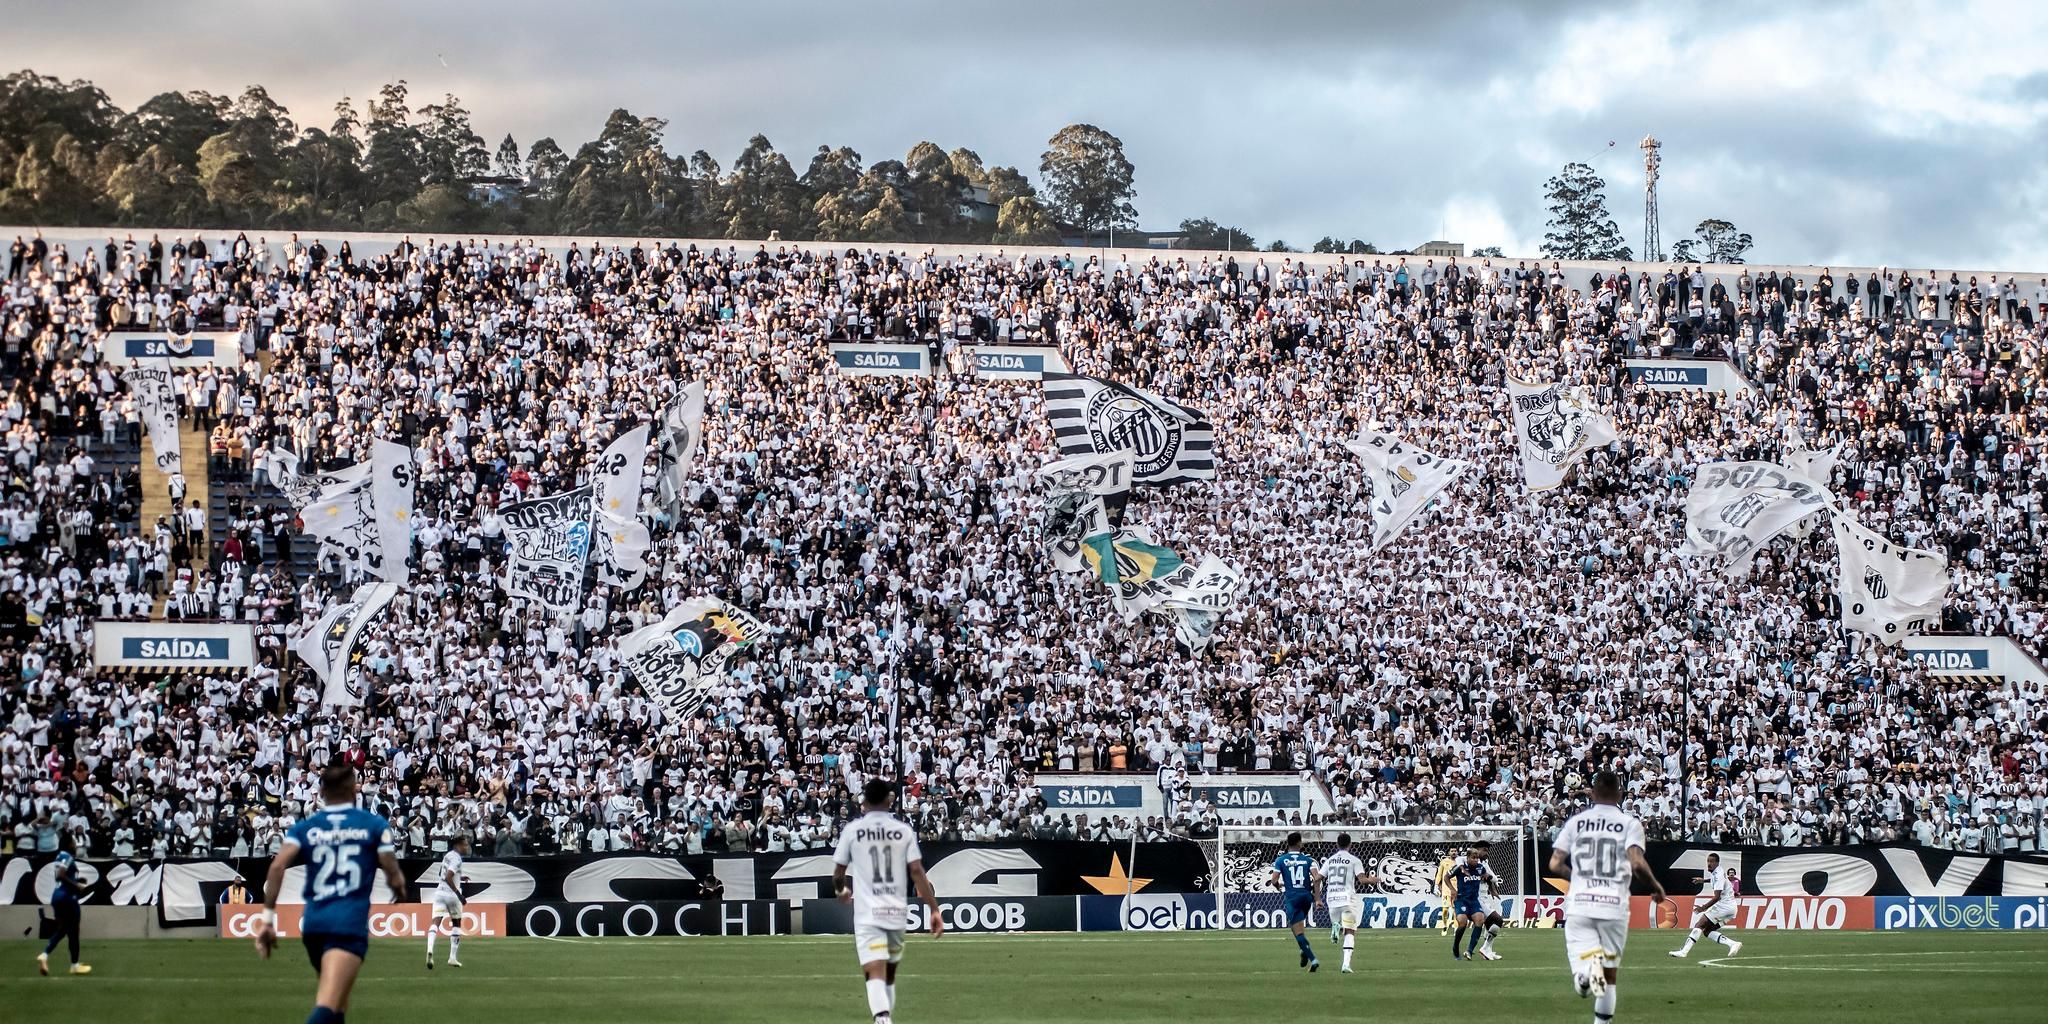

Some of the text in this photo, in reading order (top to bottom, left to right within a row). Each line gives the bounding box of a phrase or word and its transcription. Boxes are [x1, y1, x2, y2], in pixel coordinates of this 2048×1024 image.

[854, 352, 900, 367] SAÍDA
[980, 354, 1024, 369] SAÍDA
[1645, 367, 1689, 382] SAÍDA
[140, 638, 211, 658] SAÍDA
[1913, 651, 1974, 668] SAÍDA
[1058, 786, 1116, 805] SAÍDA
[1217, 787, 1274, 805] SAÍDA
[856, 827, 904, 842] Philco
[1577, 818, 1624, 833] Philco
[868, 845, 894, 883] 11
[1575, 837, 1618, 878] 20
[312, 845, 361, 899] 25
[1289, 866, 1305, 885] 14
[1329, 866, 1347, 885] 29
[525, 902, 776, 936] OGOCHI
[905, 902, 1026, 930] SICOOB
[1884, 896, 2000, 928] pixbet
[369, 912, 425, 937] GOL
